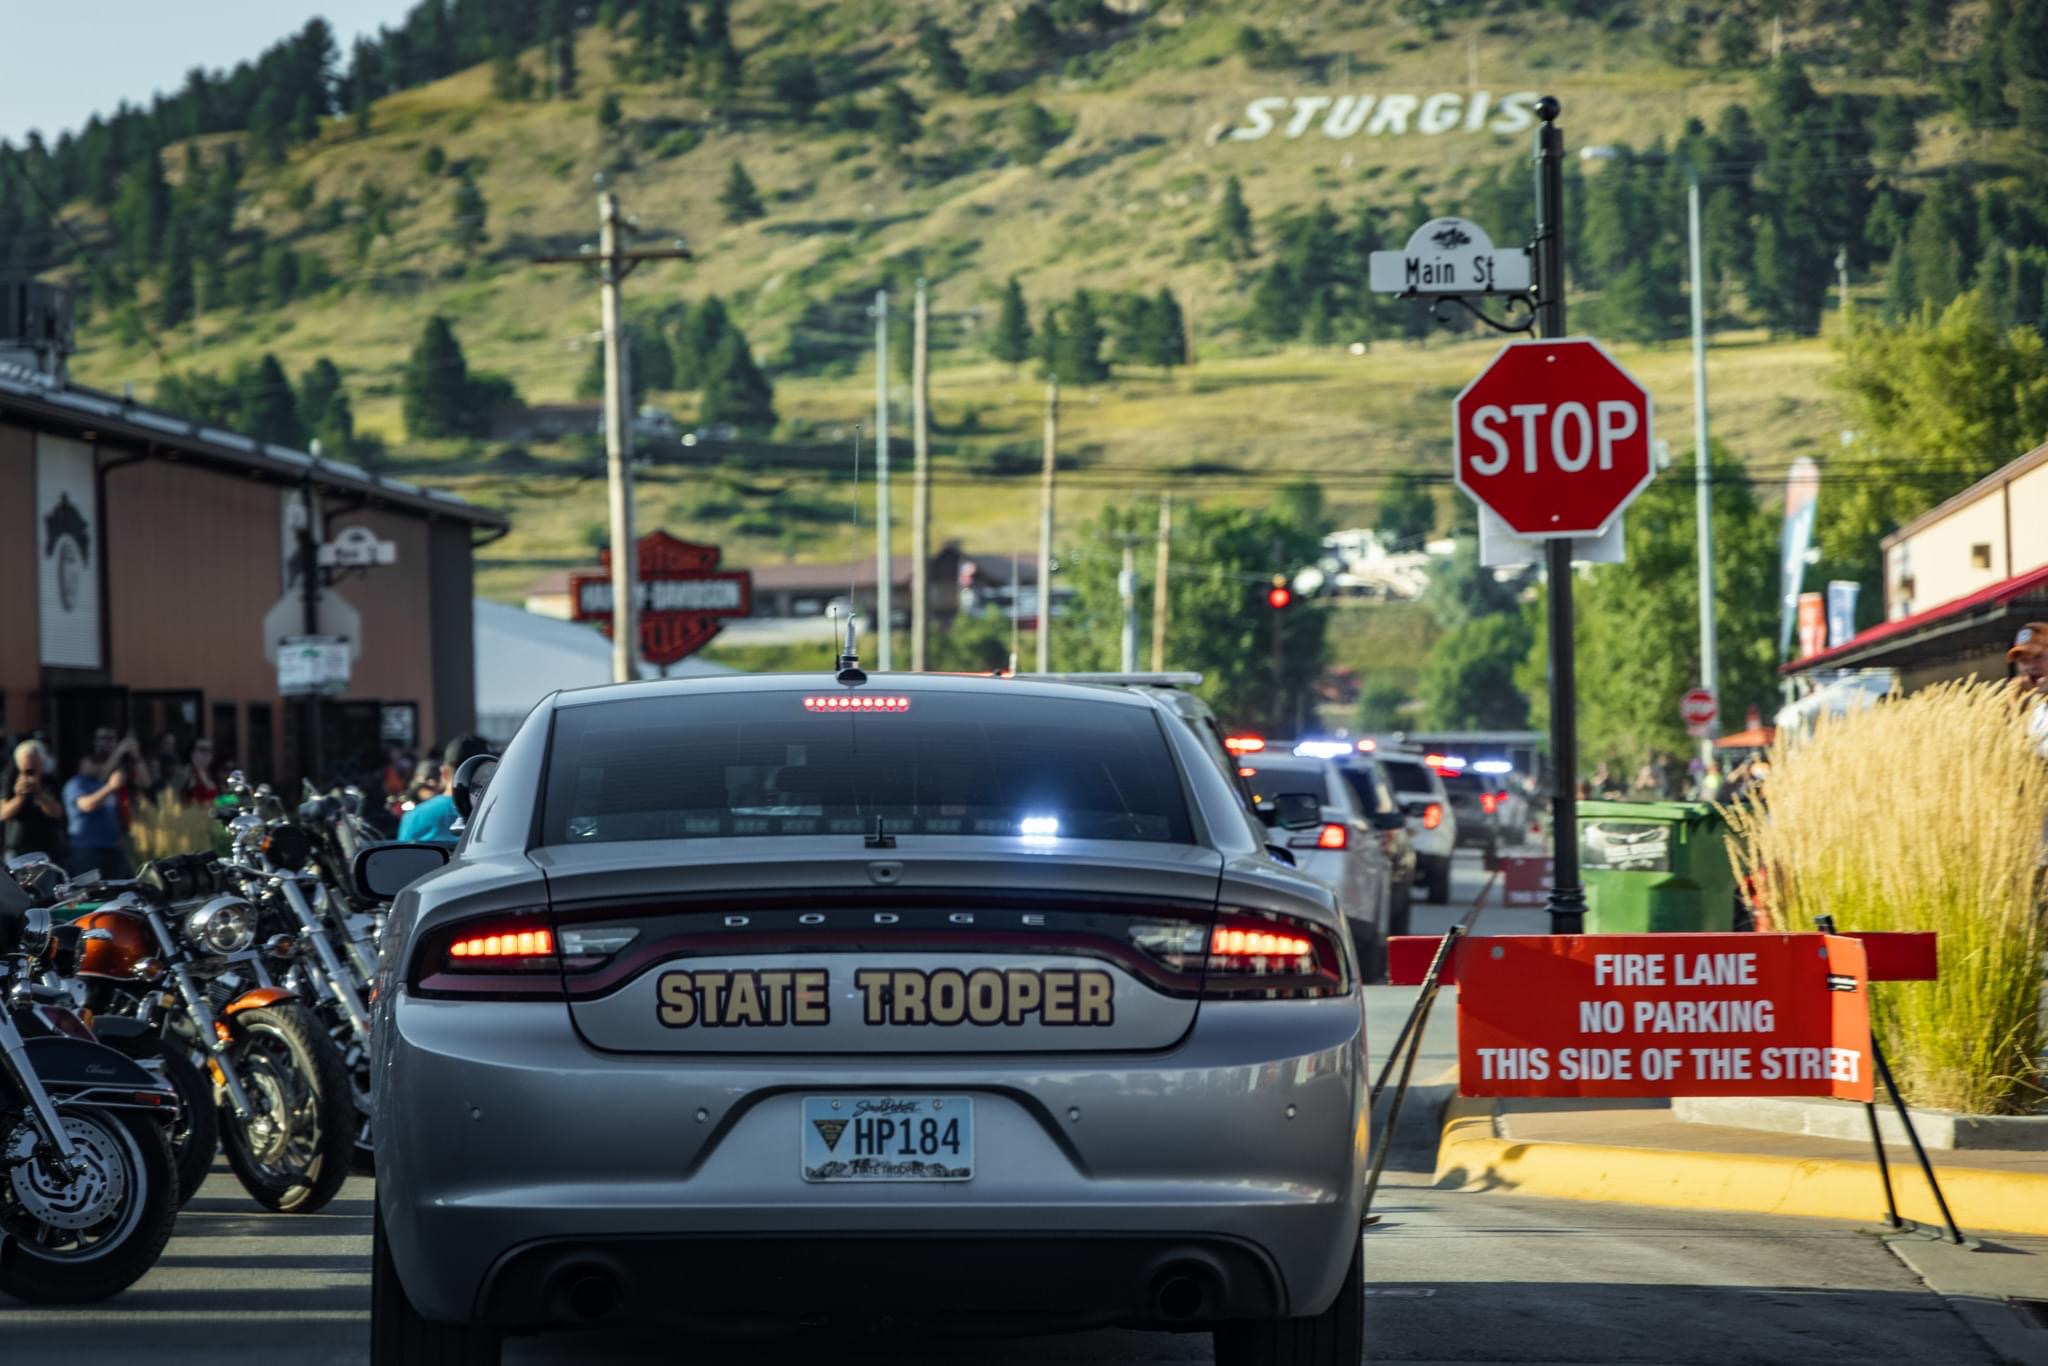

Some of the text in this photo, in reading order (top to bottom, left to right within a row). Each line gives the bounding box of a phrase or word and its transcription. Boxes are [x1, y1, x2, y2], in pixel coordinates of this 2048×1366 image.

[1230, 91, 1542, 140] STURGIS
[1405, 256, 1495, 284] Main St
[1470, 401, 1638, 477] STOP
[725, 913, 1045, 927] DODGE
[1594, 953, 1757, 986] FIRE LANE
[657, 968, 1114, 1029] STATE TROOPER
[1580, 1000, 1775, 1034] NO PARKING
[1477, 1047, 1861, 1083] THIS SIDE OF THE STREET
[855, 1118, 960, 1155] HP184
